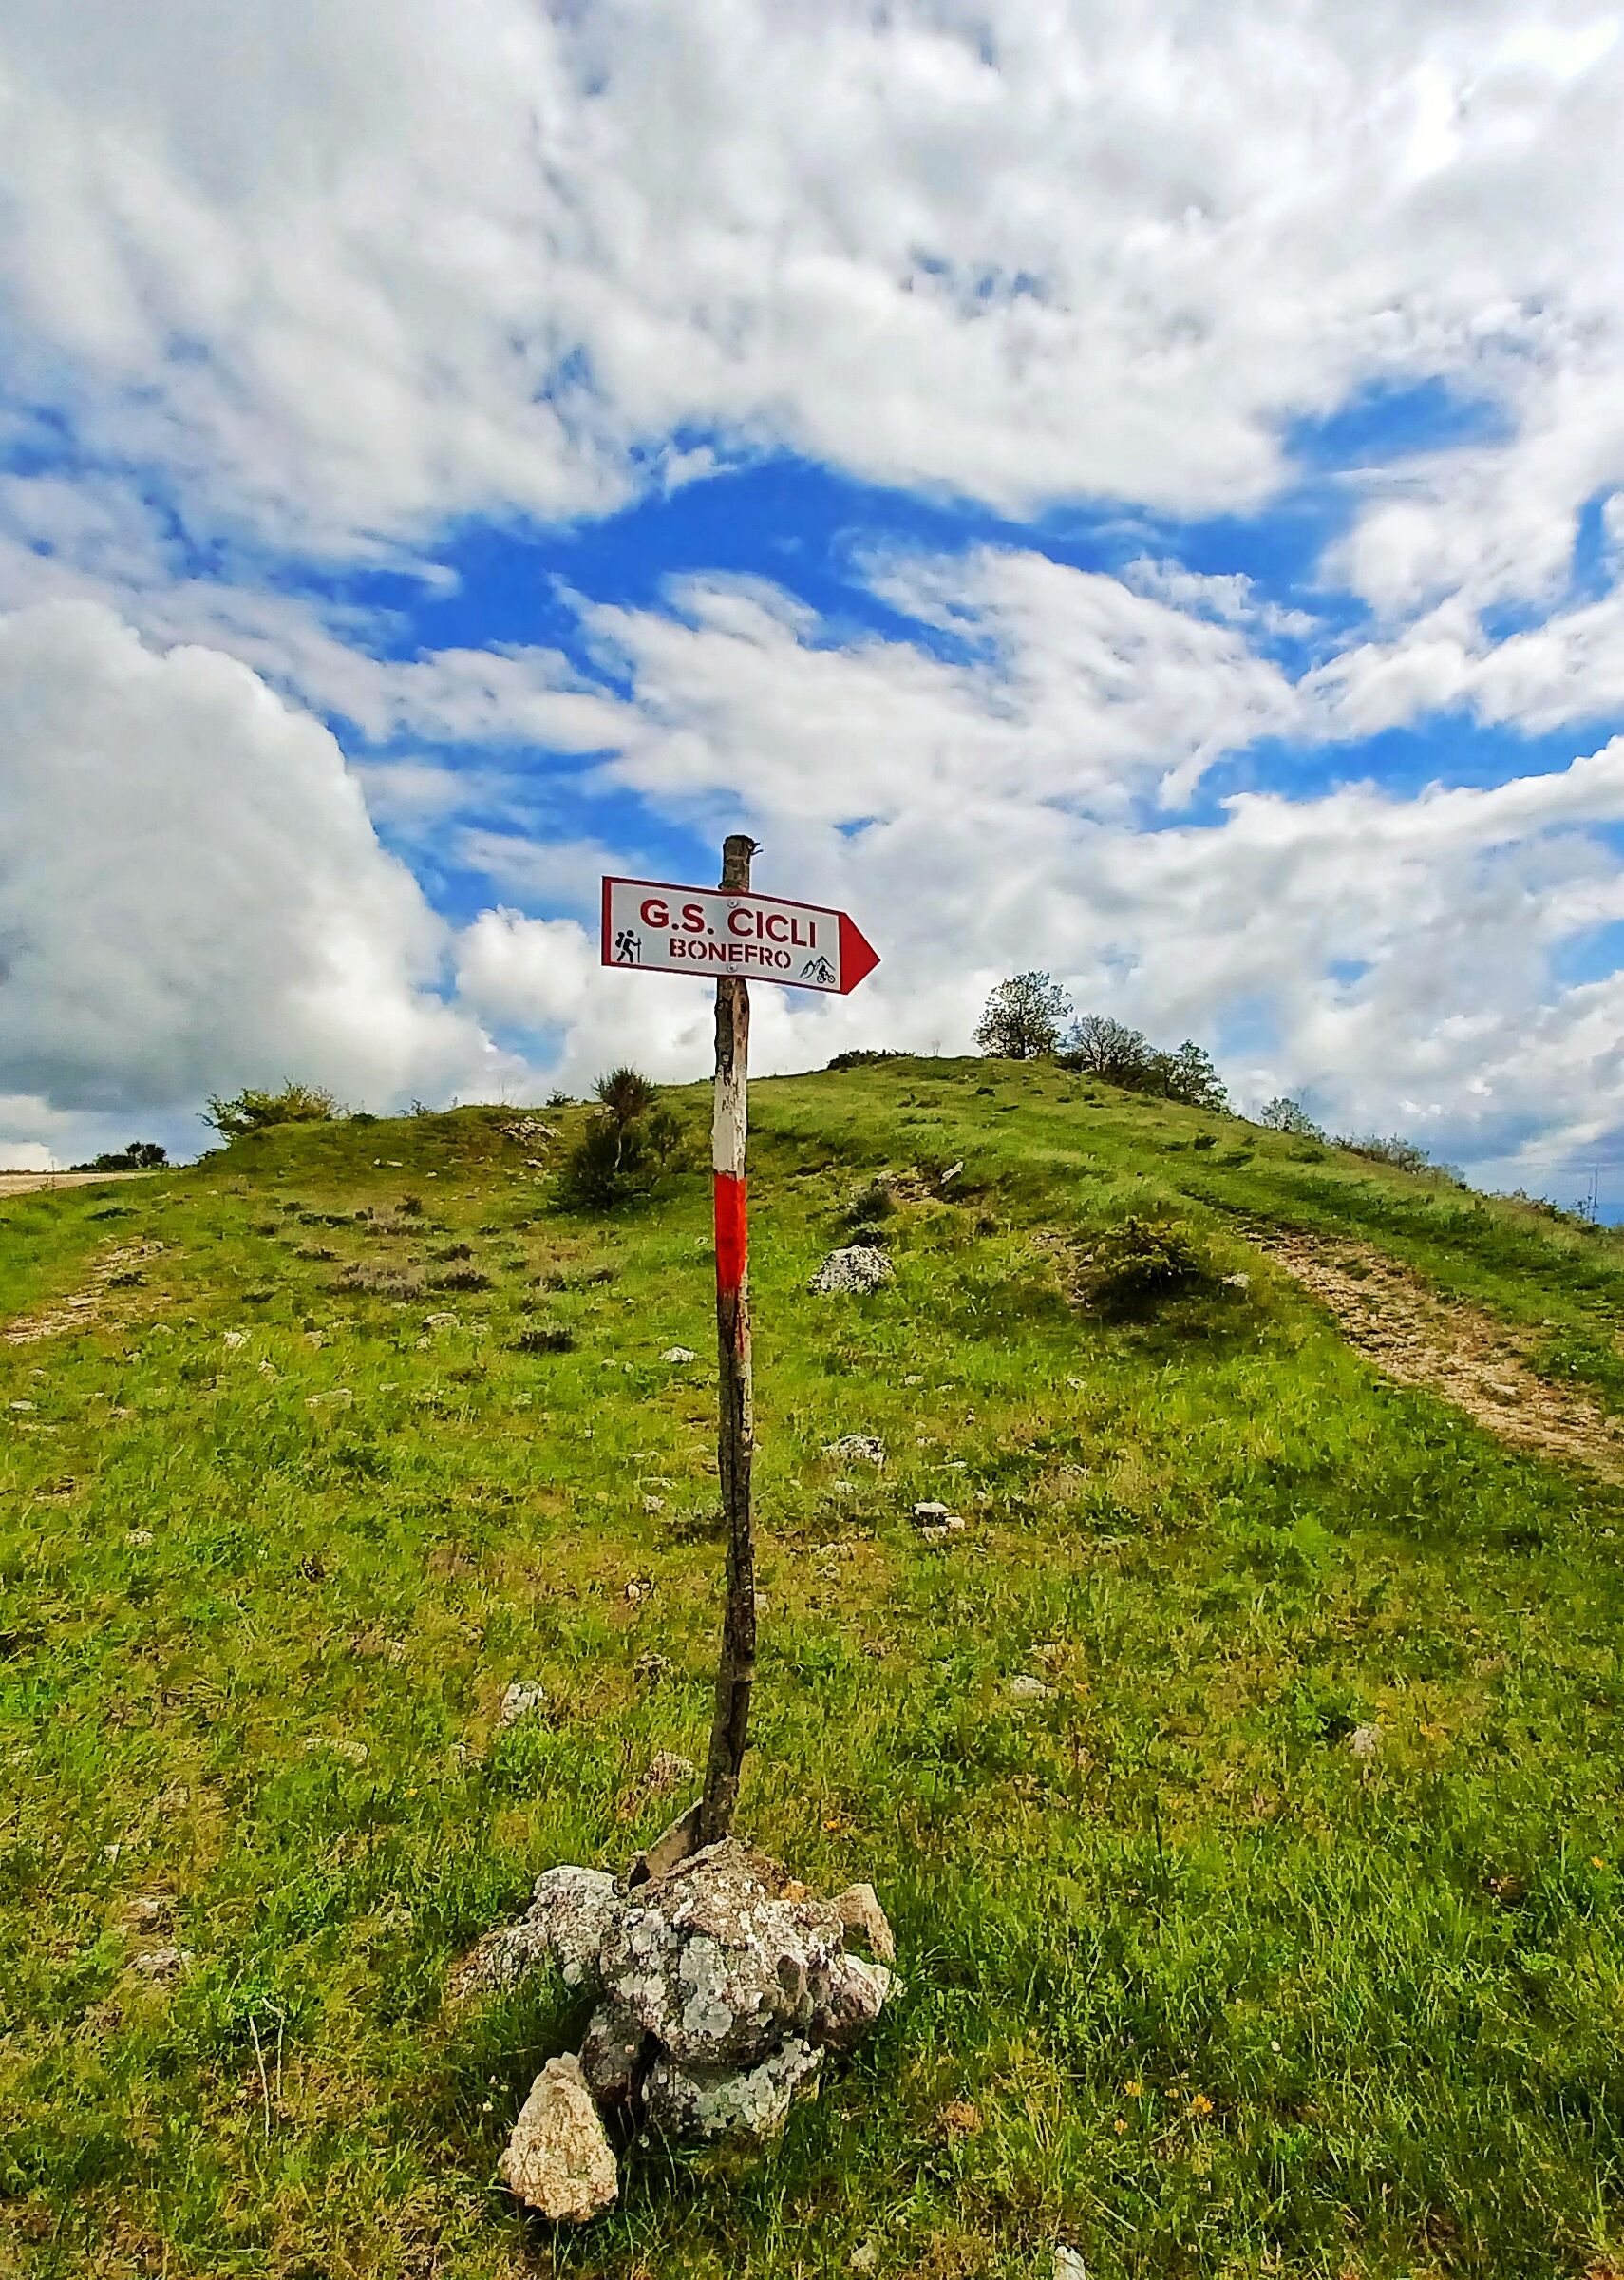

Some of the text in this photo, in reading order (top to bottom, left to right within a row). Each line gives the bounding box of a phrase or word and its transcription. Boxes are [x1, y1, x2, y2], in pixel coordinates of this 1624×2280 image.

[640, 899, 816, 948] G.S. CICLI
[670, 938, 791, 969] BONEFRO
